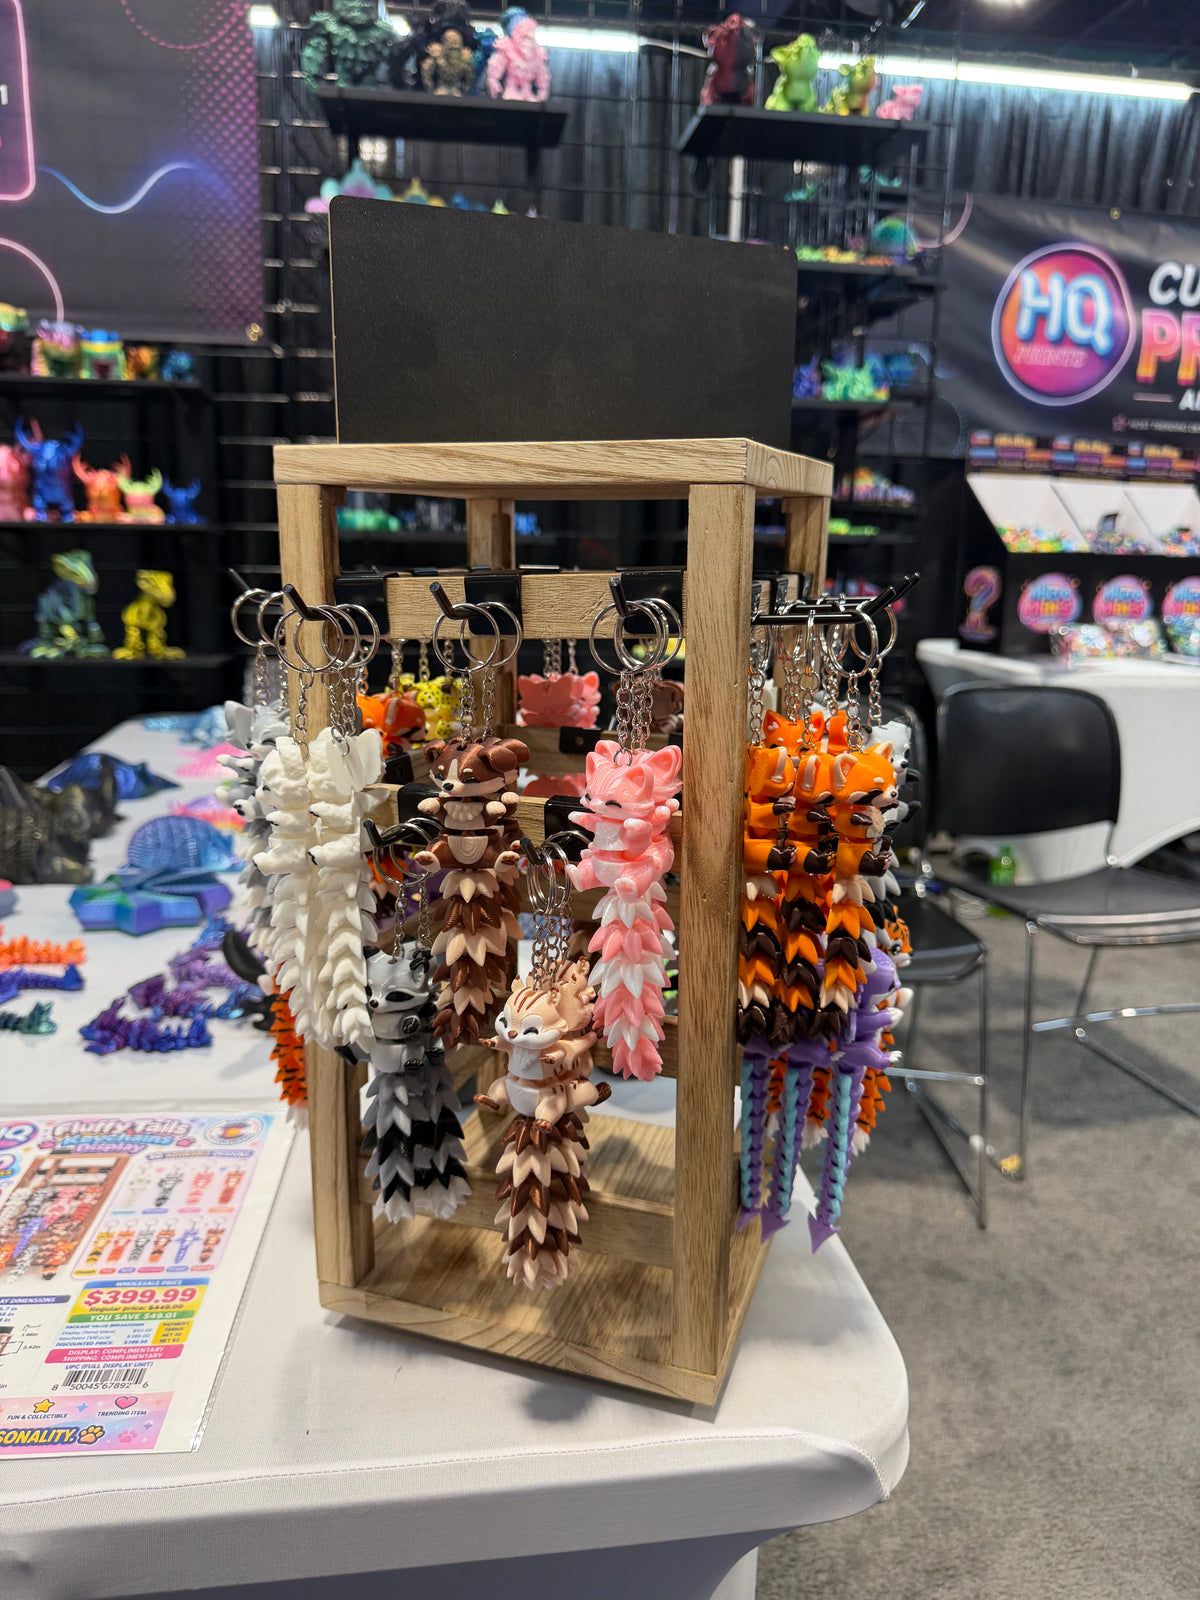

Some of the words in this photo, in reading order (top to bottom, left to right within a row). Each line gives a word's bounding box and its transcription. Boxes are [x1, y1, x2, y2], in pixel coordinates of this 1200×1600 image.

[1016, 269, 1114, 356] HQ
[53, 1118, 134, 1136] Fluffy
[134, 1118, 192, 1135] Tails
[10, 1296, 56, 1304] DIMENSIONS
[84, 1287, 197, 1307] $399.99
[90, 1314, 112, 1322] YOU
[114, 1313, 141, 1321] SAVE
[143, 1311, 177, 1320] $49.01
[102, 1346, 165, 1355] COMPLIMENTARY
[100, 1352, 164, 1361] COMPLIMENTARY
[133, 1361, 154, 1369] UNIT)
[51, 1383, 59, 1392] 8
[142, 1380, 149, 1389] 6
